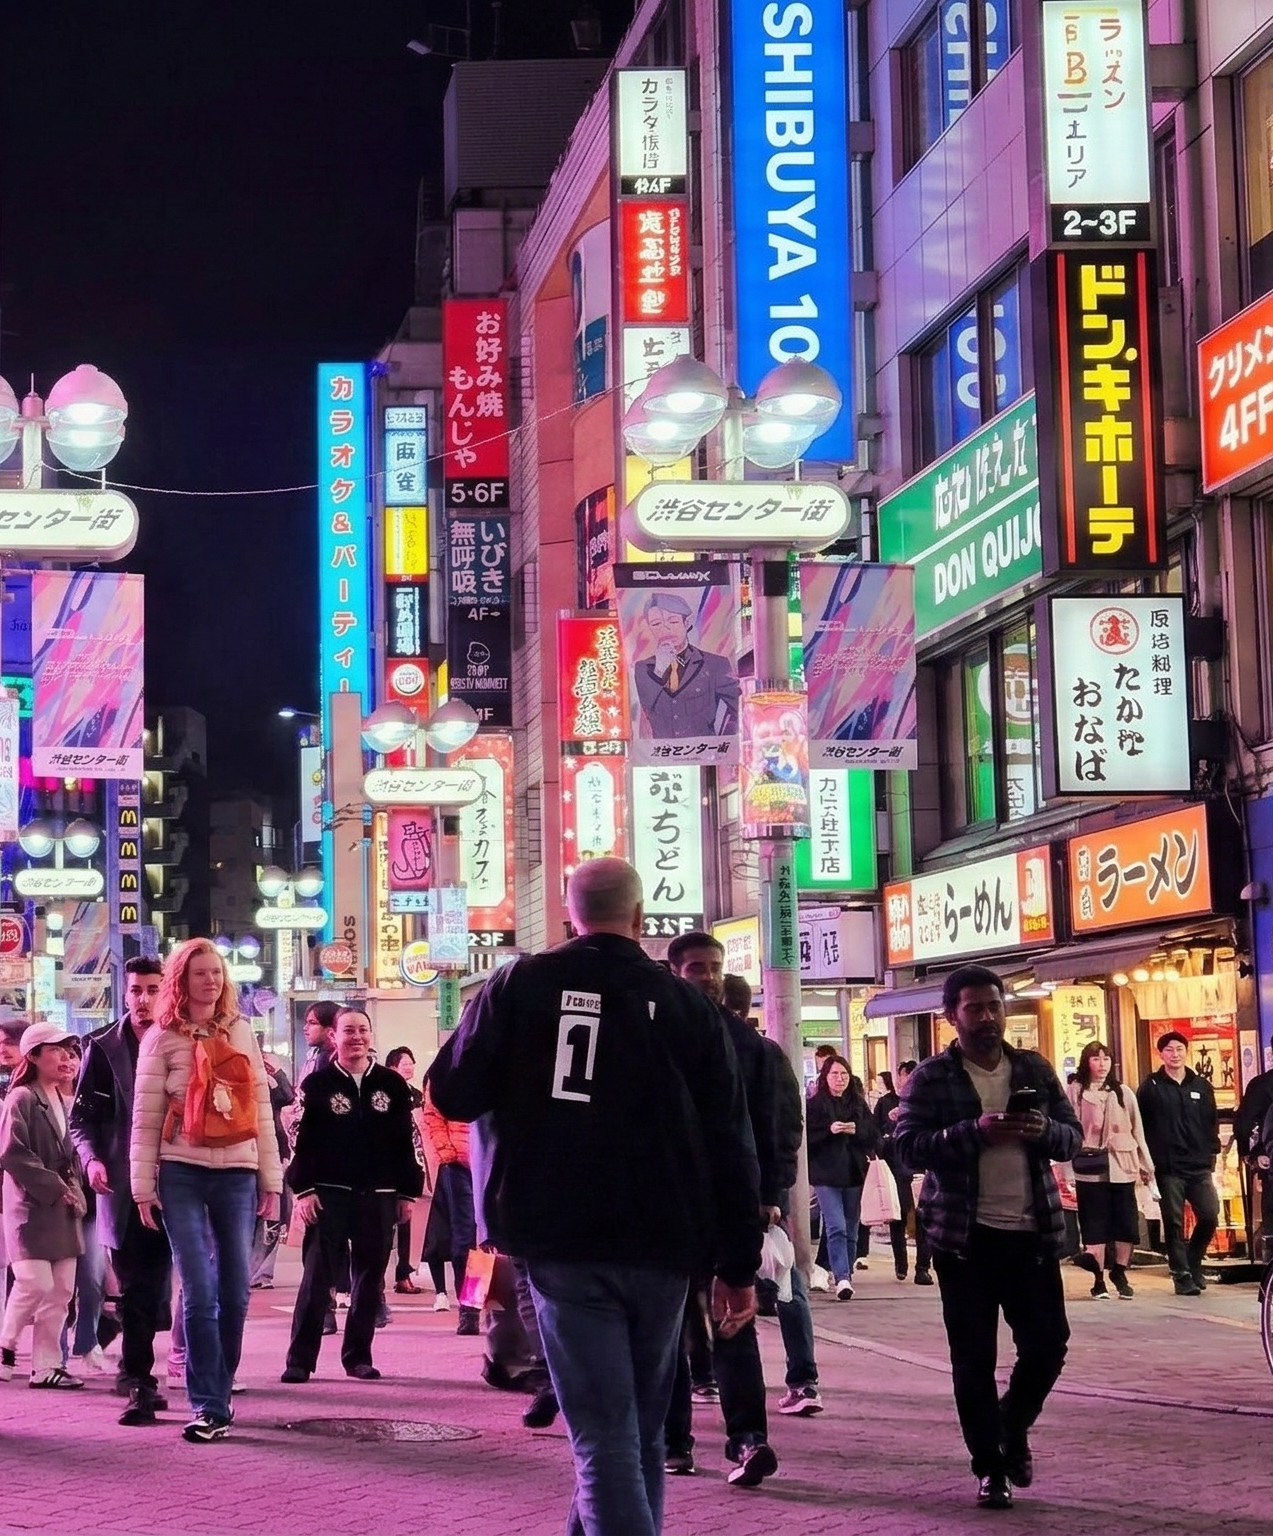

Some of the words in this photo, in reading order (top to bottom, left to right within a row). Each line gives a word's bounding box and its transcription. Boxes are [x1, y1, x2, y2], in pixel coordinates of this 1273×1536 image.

[762, 2, 818, 281] SHIBUYA
[475, 311, 506, 418] お好み焼
[448, 366, 478, 469] もんじゃ
[646, 499, 836, 523] 渋谷センター街
[450, 520, 477, 594] 無呼吸
[480, 520, 506, 593] いびき
[934, 541, 977, 606] DON
[1072, 677, 1108, 782] おなば
[1097, 832, 1198, 909] ラーメン
[943, 876, 1013, 944] らーめん
